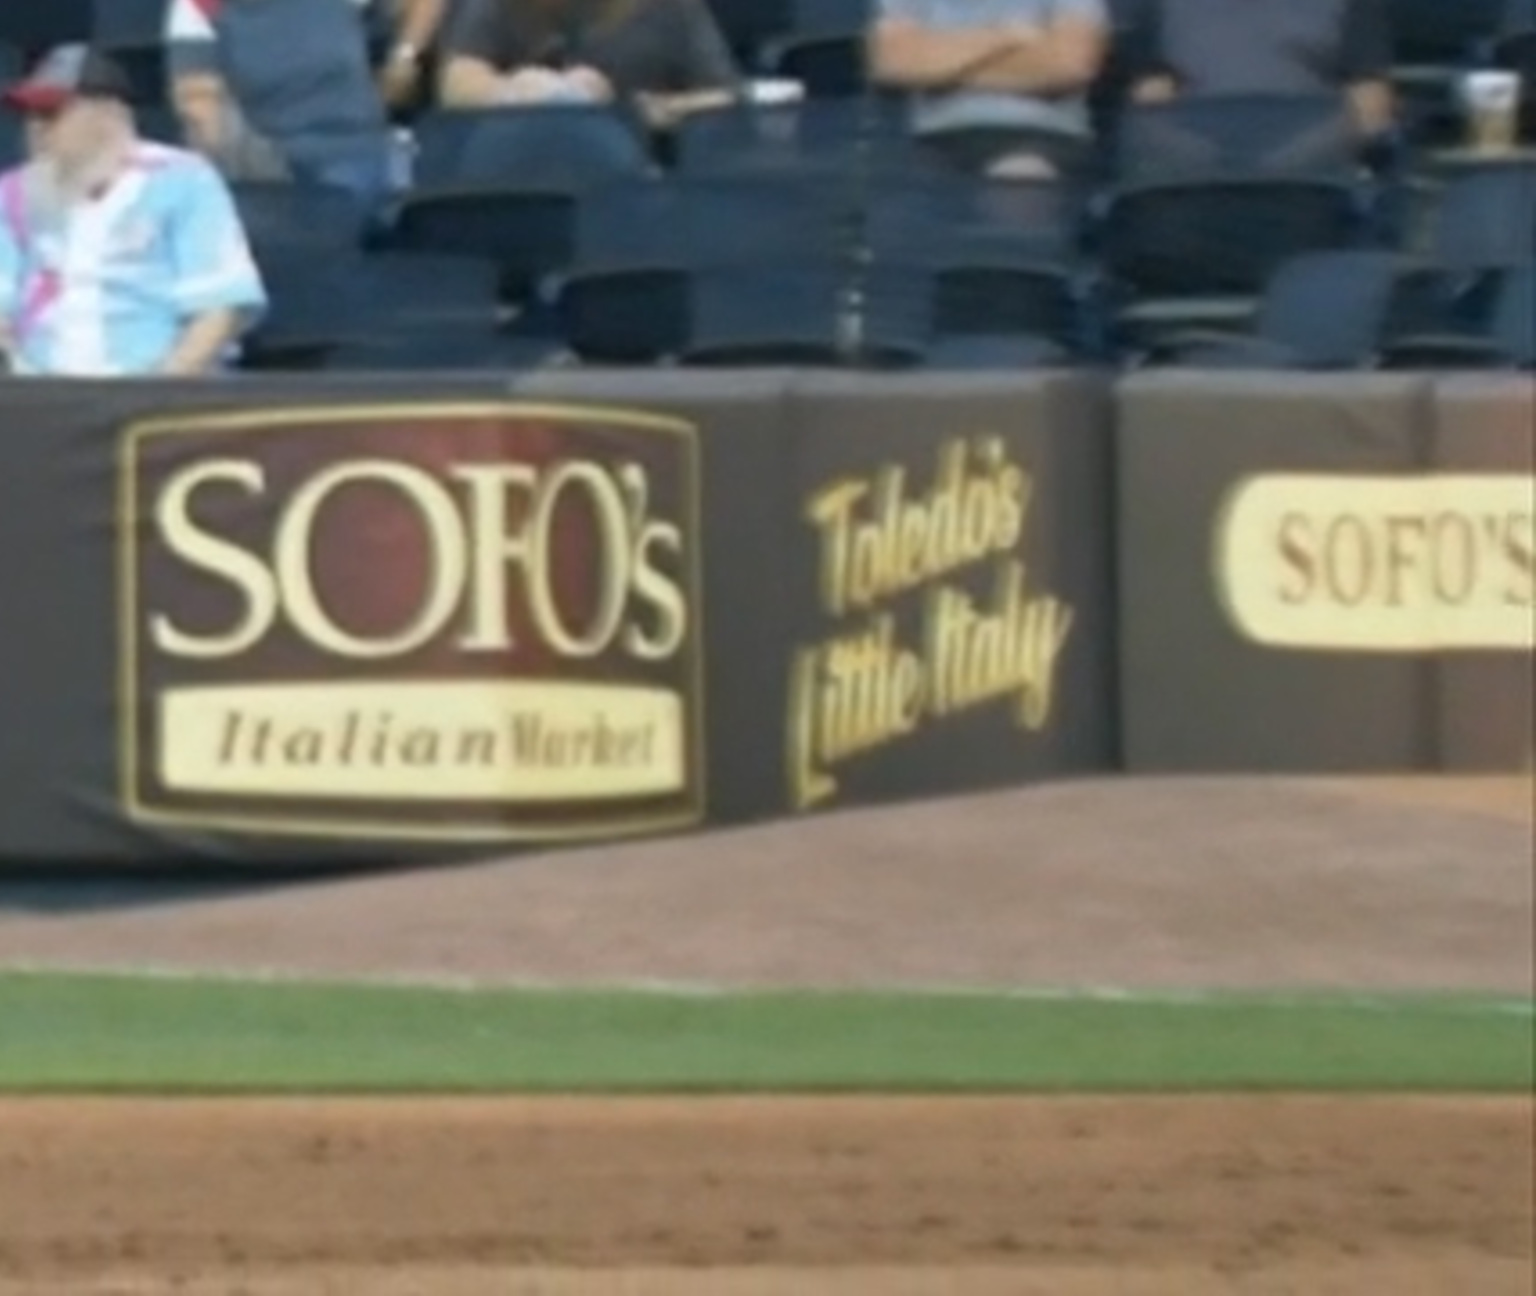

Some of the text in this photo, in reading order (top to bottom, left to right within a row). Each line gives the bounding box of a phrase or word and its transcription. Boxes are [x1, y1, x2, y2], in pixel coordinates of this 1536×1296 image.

[806, 436, 1032, 616] Toledo's
[217, 708, 657, 770] Italian Market
[788, 558, 1075, 810] Little Italy
